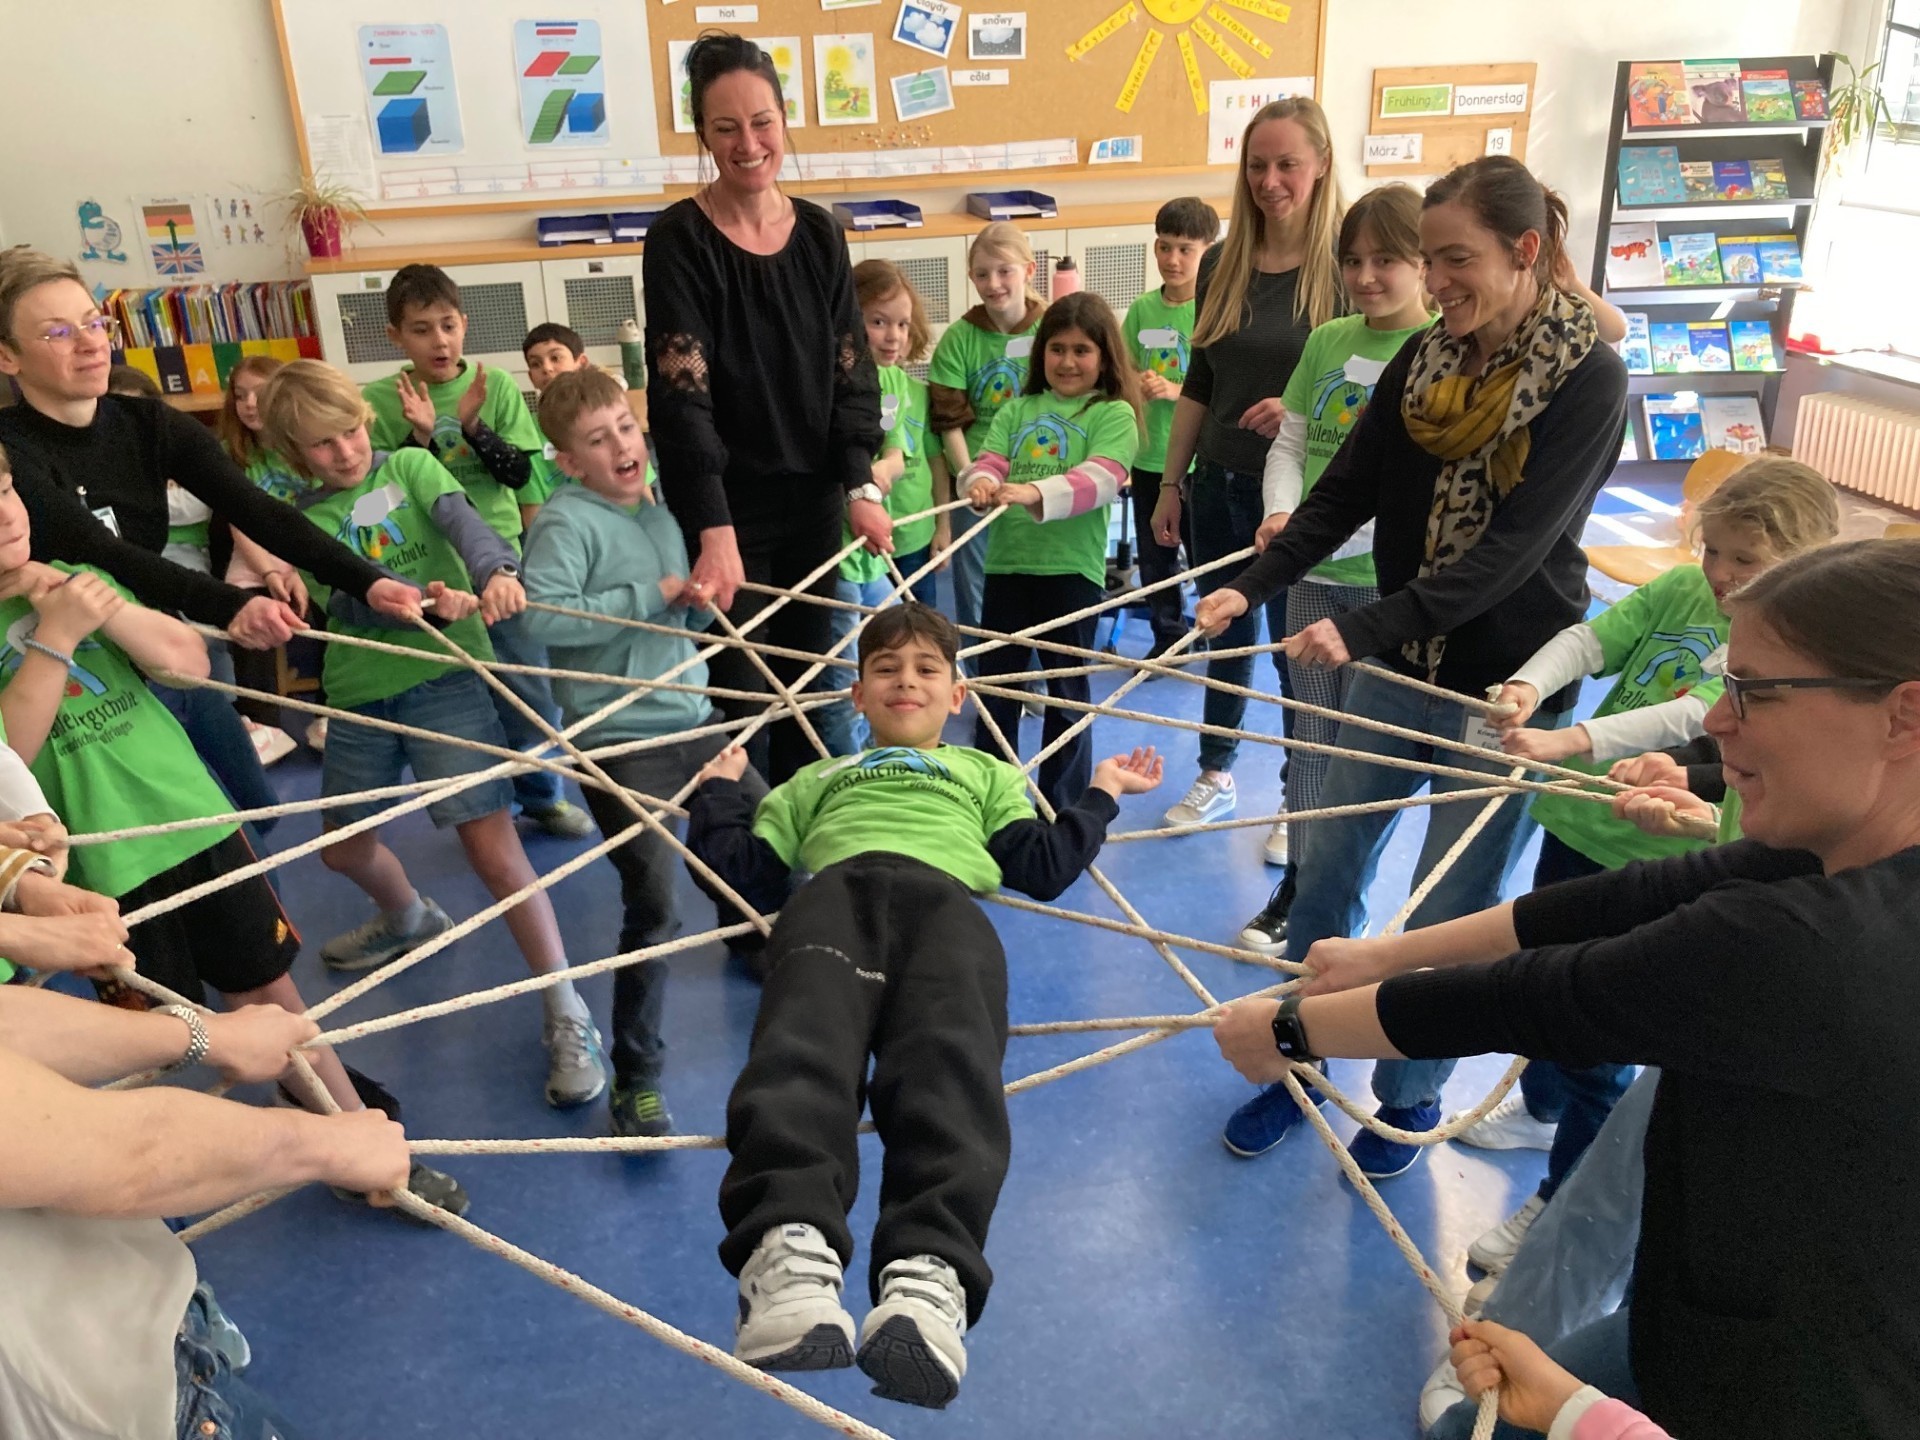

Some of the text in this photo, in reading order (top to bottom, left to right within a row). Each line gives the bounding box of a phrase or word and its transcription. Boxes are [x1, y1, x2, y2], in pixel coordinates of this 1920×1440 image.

[719, 9, 735, 18] hot
[982, 16, 1013, 27] snowy
[969, 71, 990, 82] cold
[1387, 95, 1431, 107] Frühling
[1458, 92, 1523, 107] Donnerstag
[1369, 141, 1398, 156] März
[1490, 136, 1504, 150] 19
[167, 374, 183, 392] E
[196, 369, 212, 386] A
